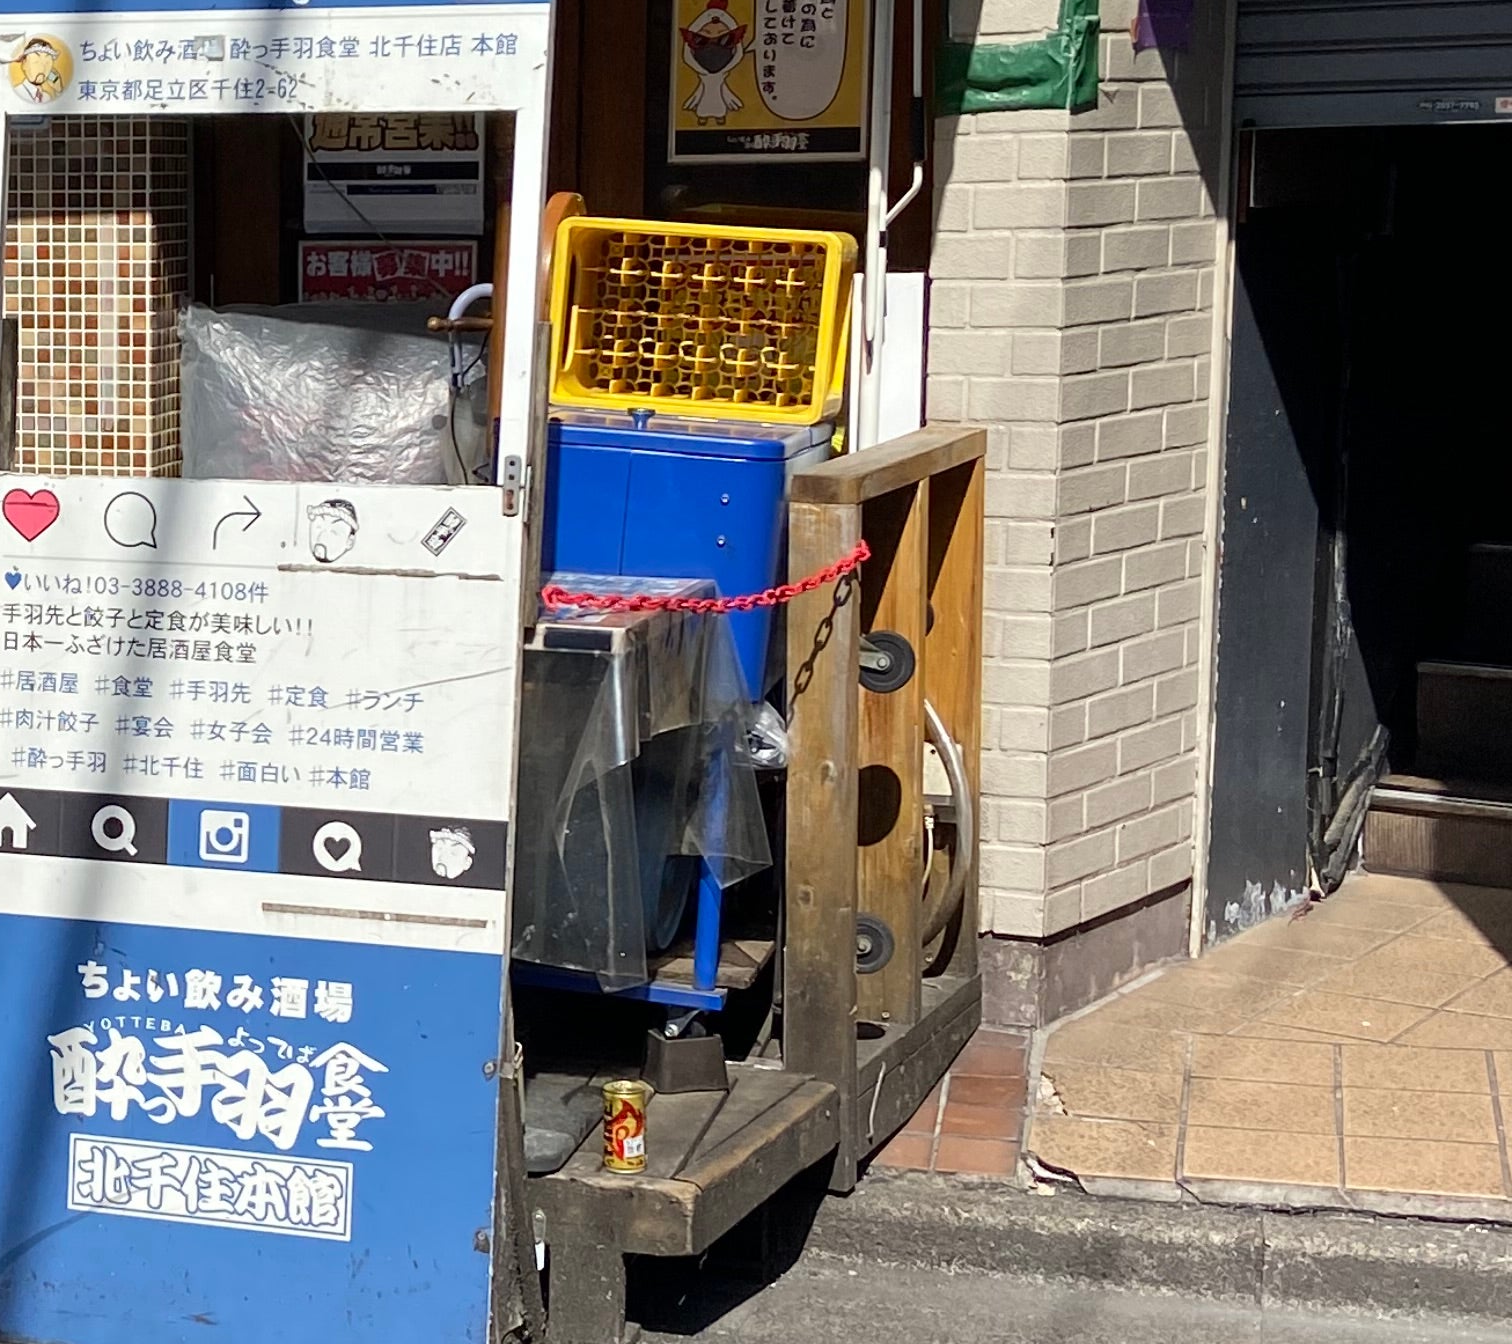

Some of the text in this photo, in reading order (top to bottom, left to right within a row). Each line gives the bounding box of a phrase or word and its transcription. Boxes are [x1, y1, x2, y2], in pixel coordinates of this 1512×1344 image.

[80, 33, 518, 64] ちょい飲み酒 酔っ手羽食堂 北千住店 本館
[0, 669, 425, 714] #居酒屋 #食堂 #手羽先 #定食 #ランチ
[115, 714, 175, 740] #宴会
[190, 719, 273, 746] #女子会
[288, 724, 425, 755] #24時間営業
[11, 746, 372, 790] #酔っ手羽 #北千住 #面白い #本館
[77, 960, 354, 1024] ちょい飲み酒場
[309, 1041, 389, 1152] 食堂
[77, 1145, 344, 1227] 北千住本館
